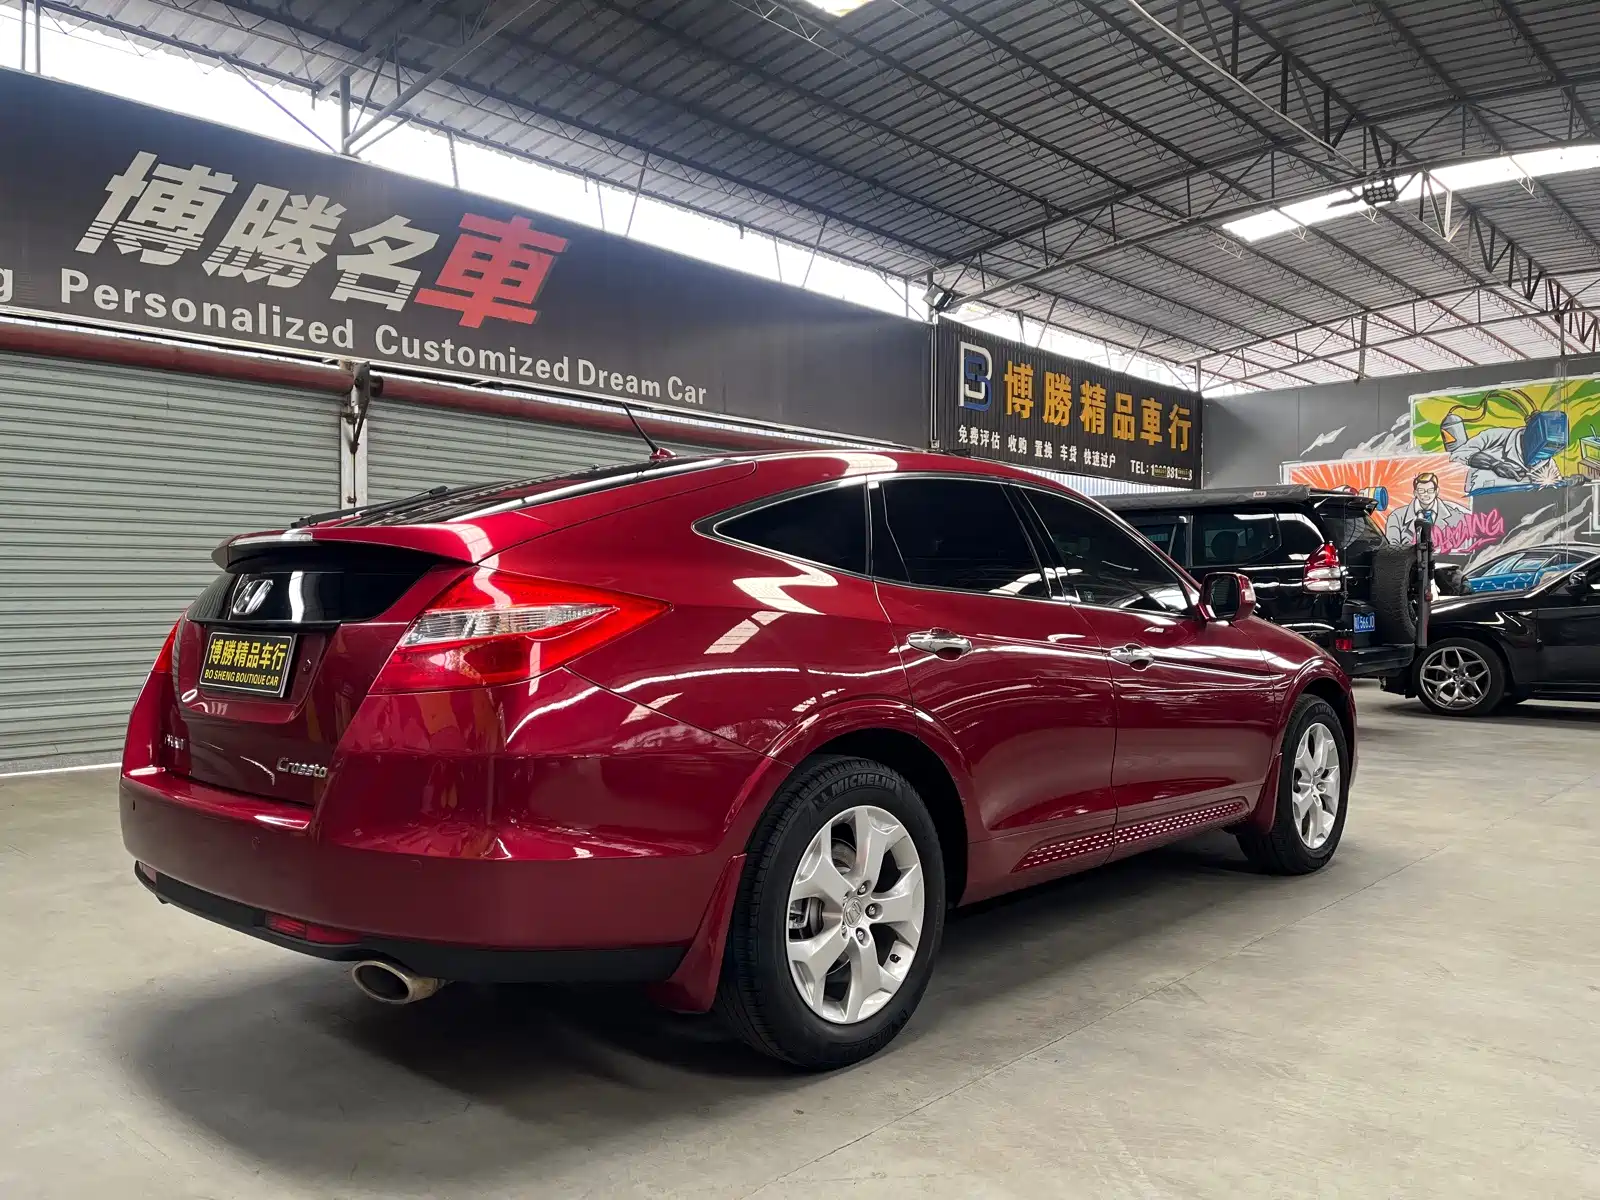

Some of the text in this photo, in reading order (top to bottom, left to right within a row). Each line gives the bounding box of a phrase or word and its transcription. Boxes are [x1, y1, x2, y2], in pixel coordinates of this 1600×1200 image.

[75, 151, 568, 328] 博勝名車
[61, 268, 353, 349] Personalized
[375, 324, 569, 382] Customized
[578, 359, 661, 398] Dream
[667, 375, 707, 405] Car
[1004, 360, 1192, 451] 博勝精品車行
[958, 425, 1000, 449] 免费评估
[1008, 434, 1027, 454] 收购
[1083, 448, 1116, 468] 快速过户
[204, 669, 279, 686] BO SHENG BOUTIQUE CAR
[831, 773, 896, 797] MICHELIN
